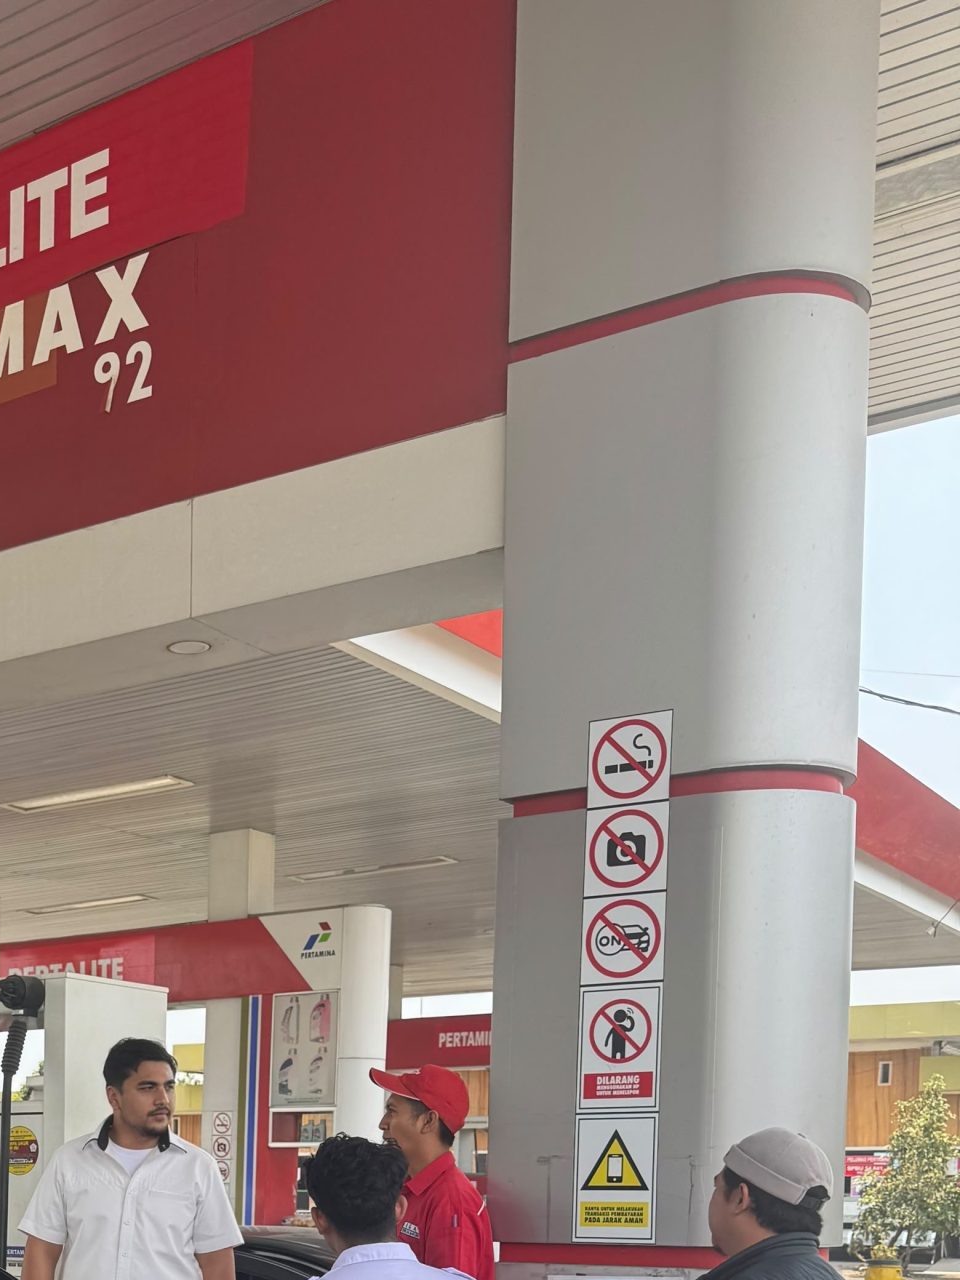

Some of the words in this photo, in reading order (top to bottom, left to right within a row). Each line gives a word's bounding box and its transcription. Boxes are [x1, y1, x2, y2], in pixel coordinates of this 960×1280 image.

[93, 341, 154, 413] 92
[599, 935, 621, 947] ON
[301, 950, 335, 960] PERTAMINA
[596, 1075, 640, 1085] DILARANG
